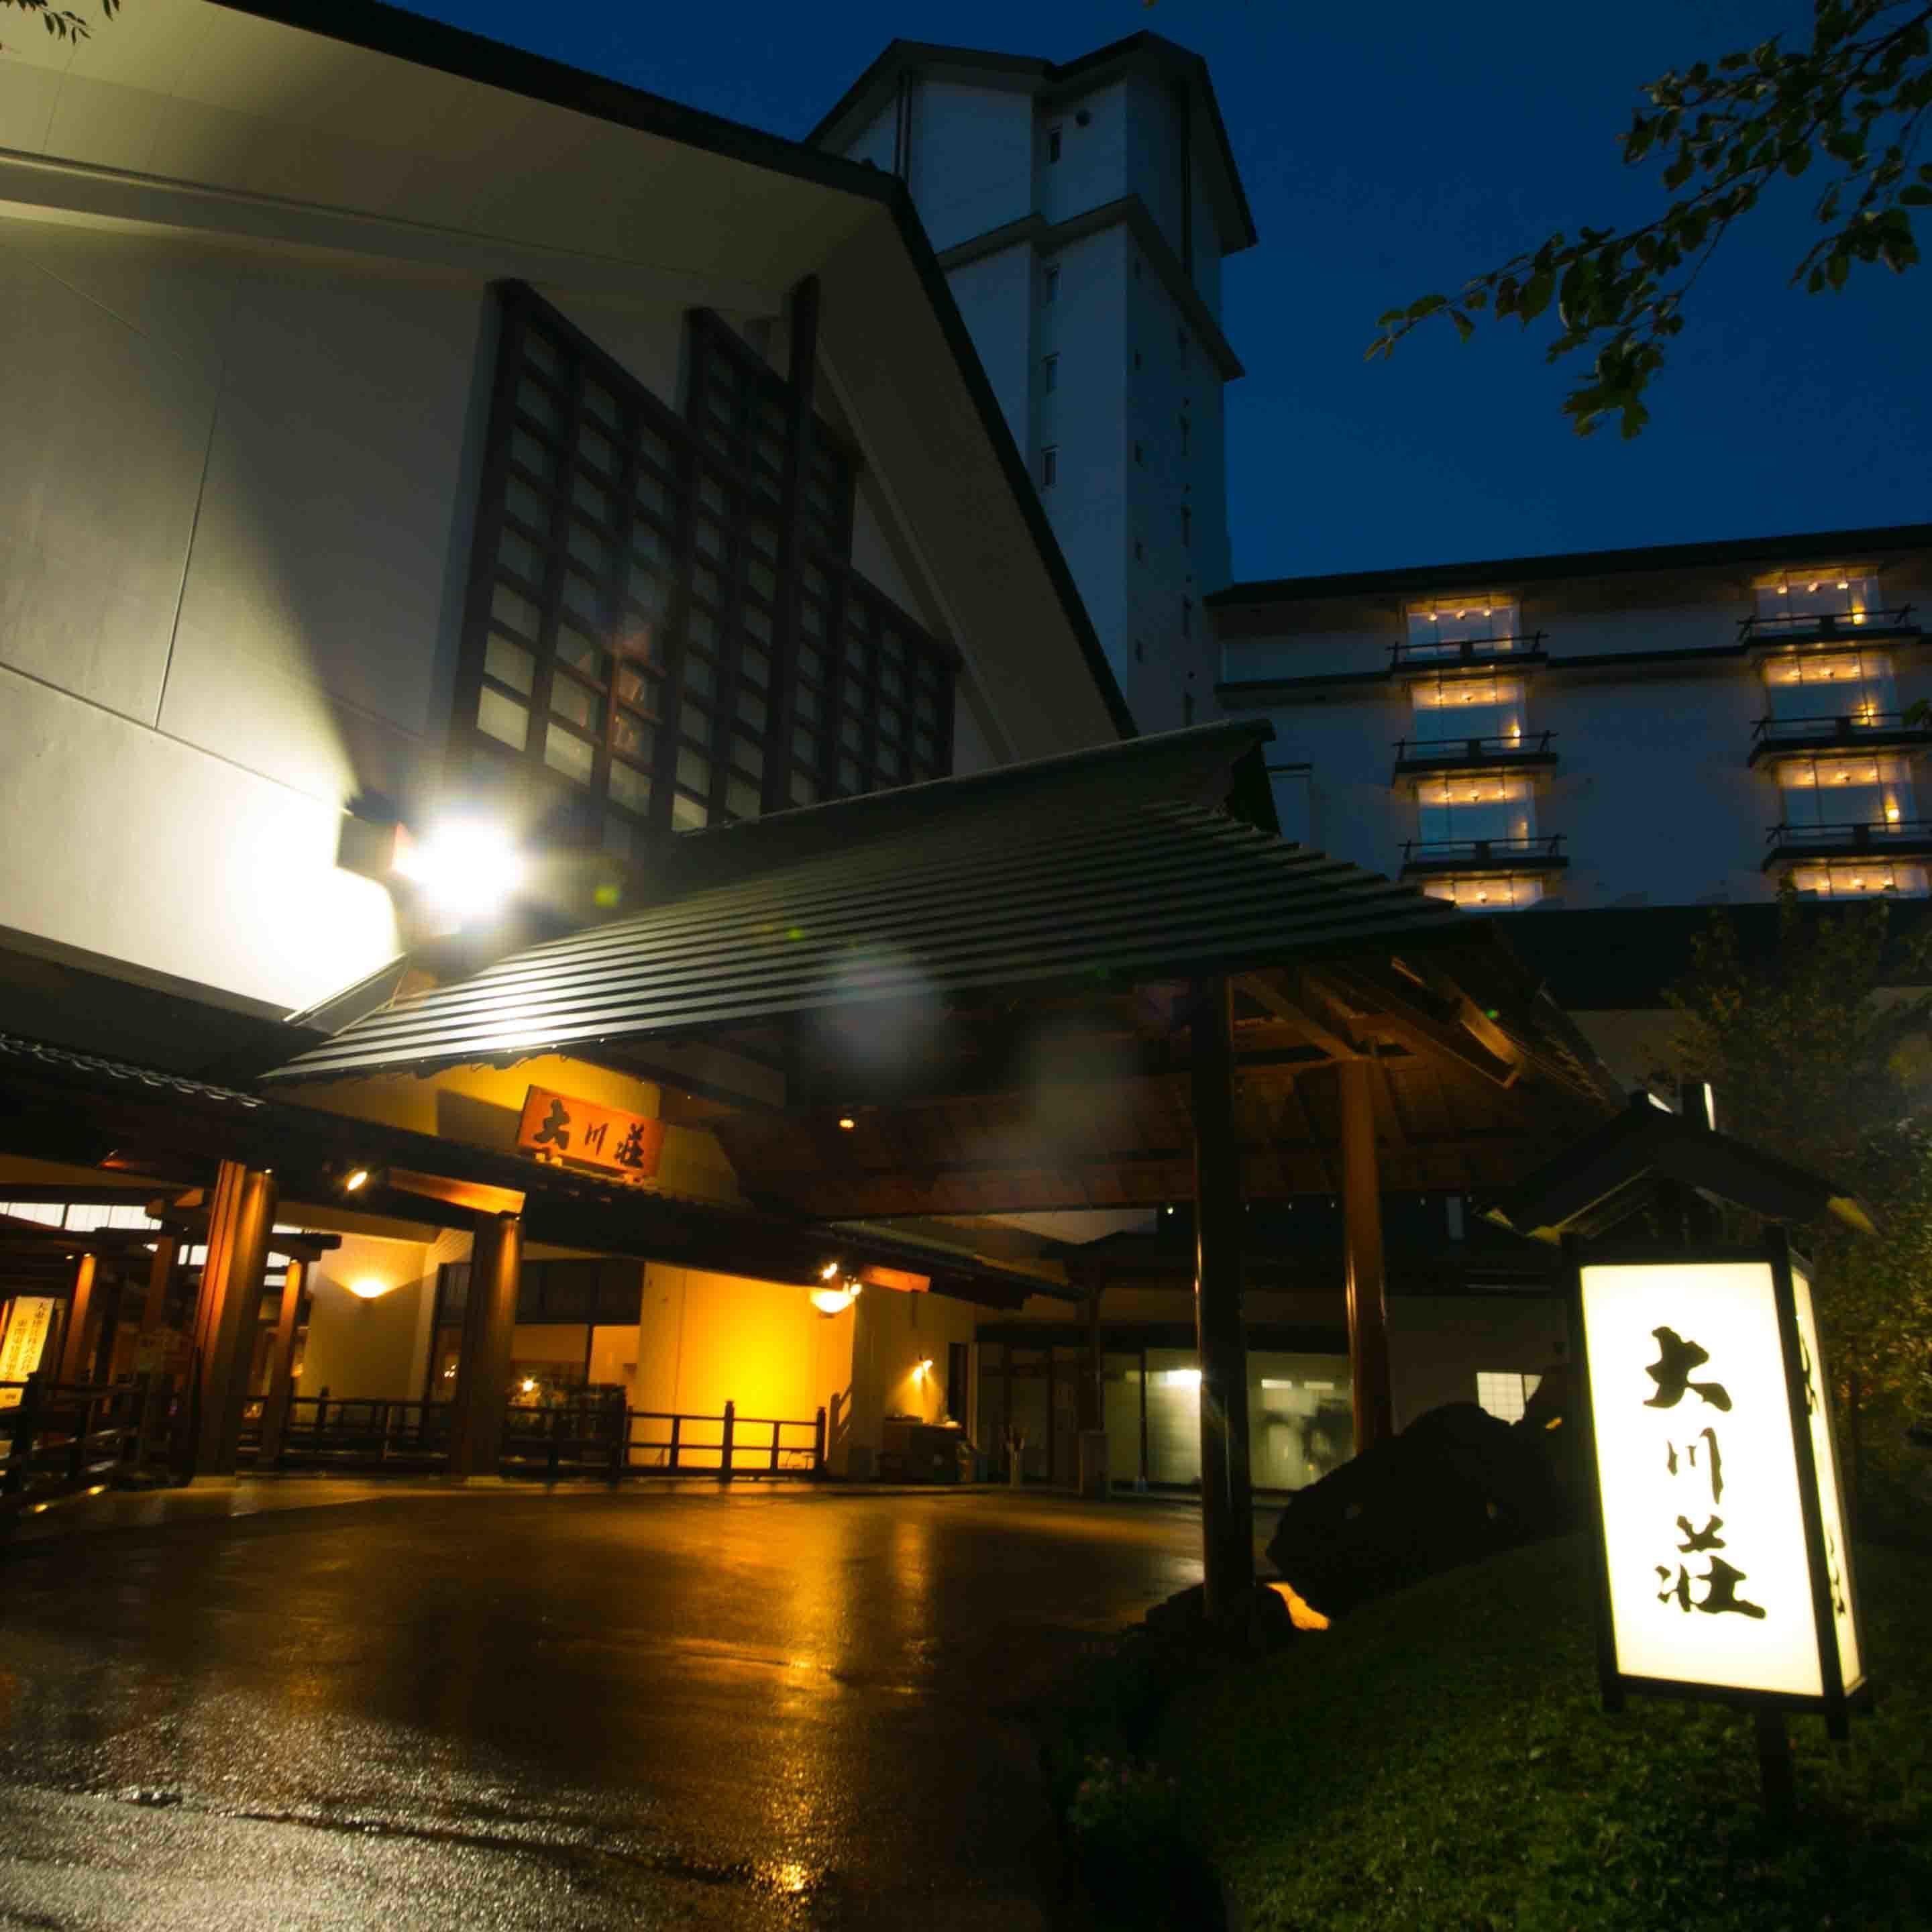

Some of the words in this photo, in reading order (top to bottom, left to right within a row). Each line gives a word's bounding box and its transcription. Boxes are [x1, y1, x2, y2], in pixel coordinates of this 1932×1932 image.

[533, 1098, 645, 1169] 大川荘
[1643, 1326, 1766, 1620] 大川荘
